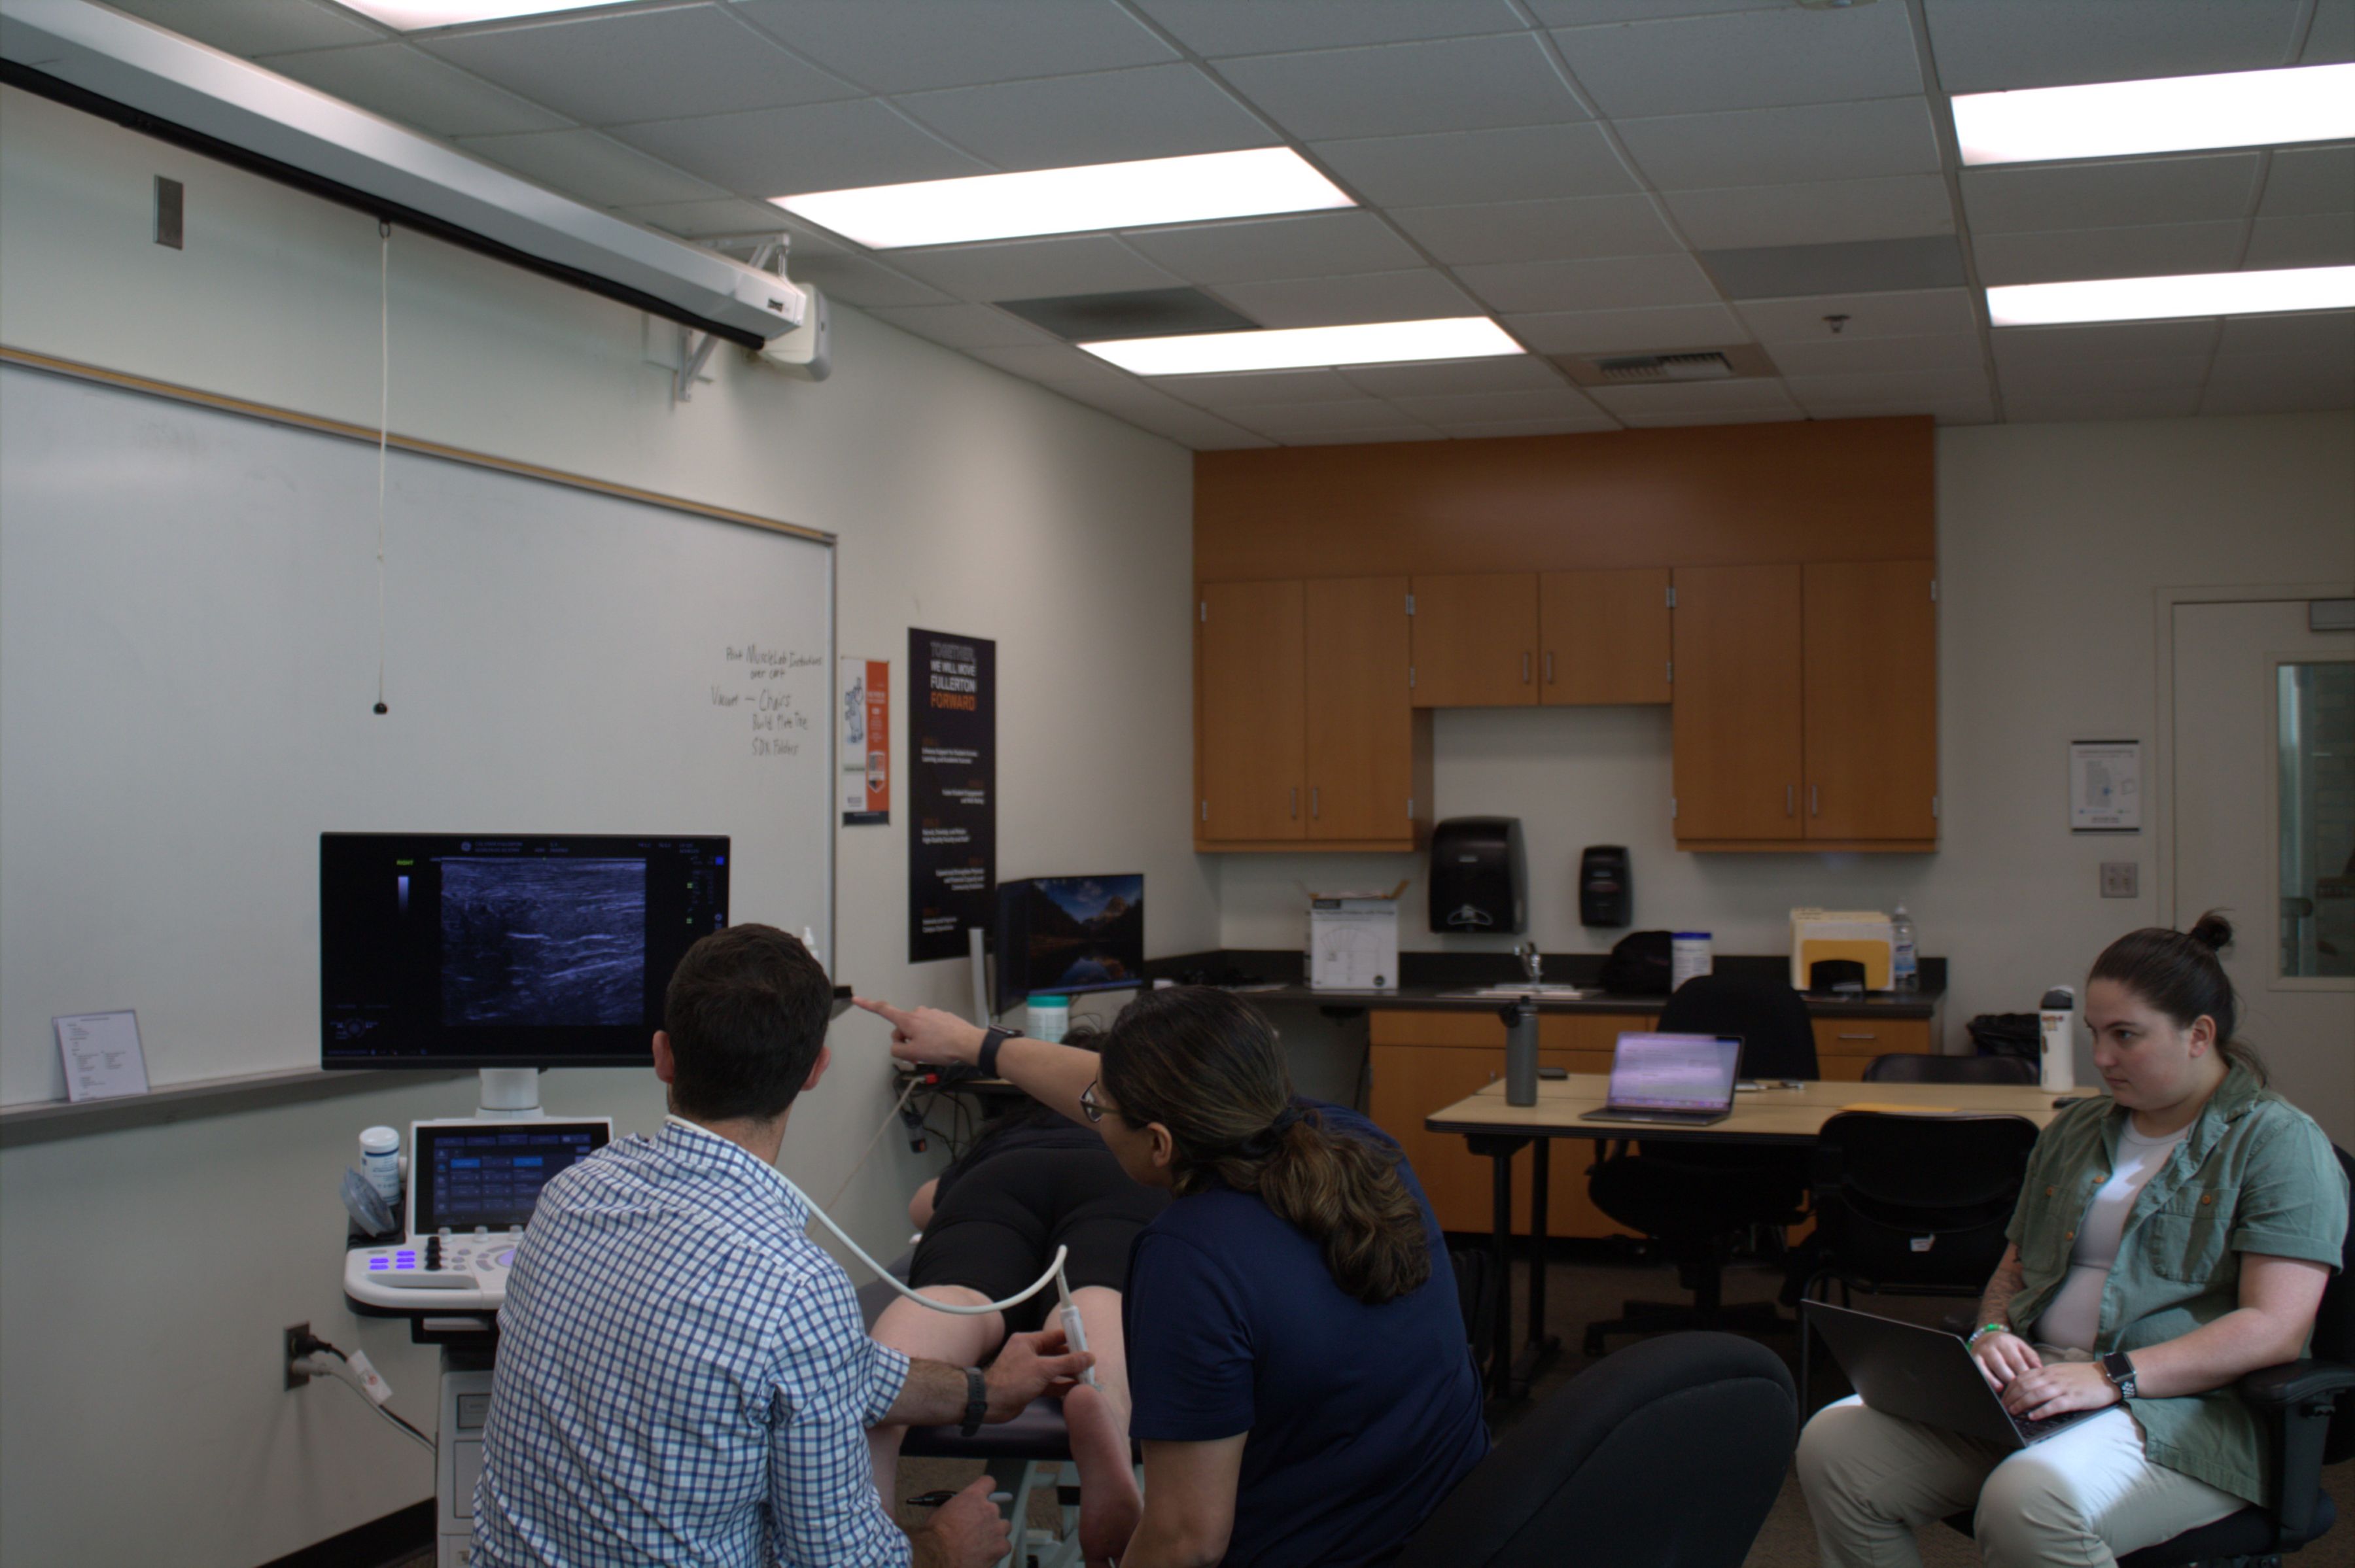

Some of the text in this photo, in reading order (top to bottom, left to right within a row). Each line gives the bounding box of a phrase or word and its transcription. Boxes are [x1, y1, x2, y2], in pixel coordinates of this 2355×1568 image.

[930, 659, 976, 676] WE WILL MOVE
[930, 674, 975, 693] FULLERTON
[931, 691, 975, 711] FORWARD
